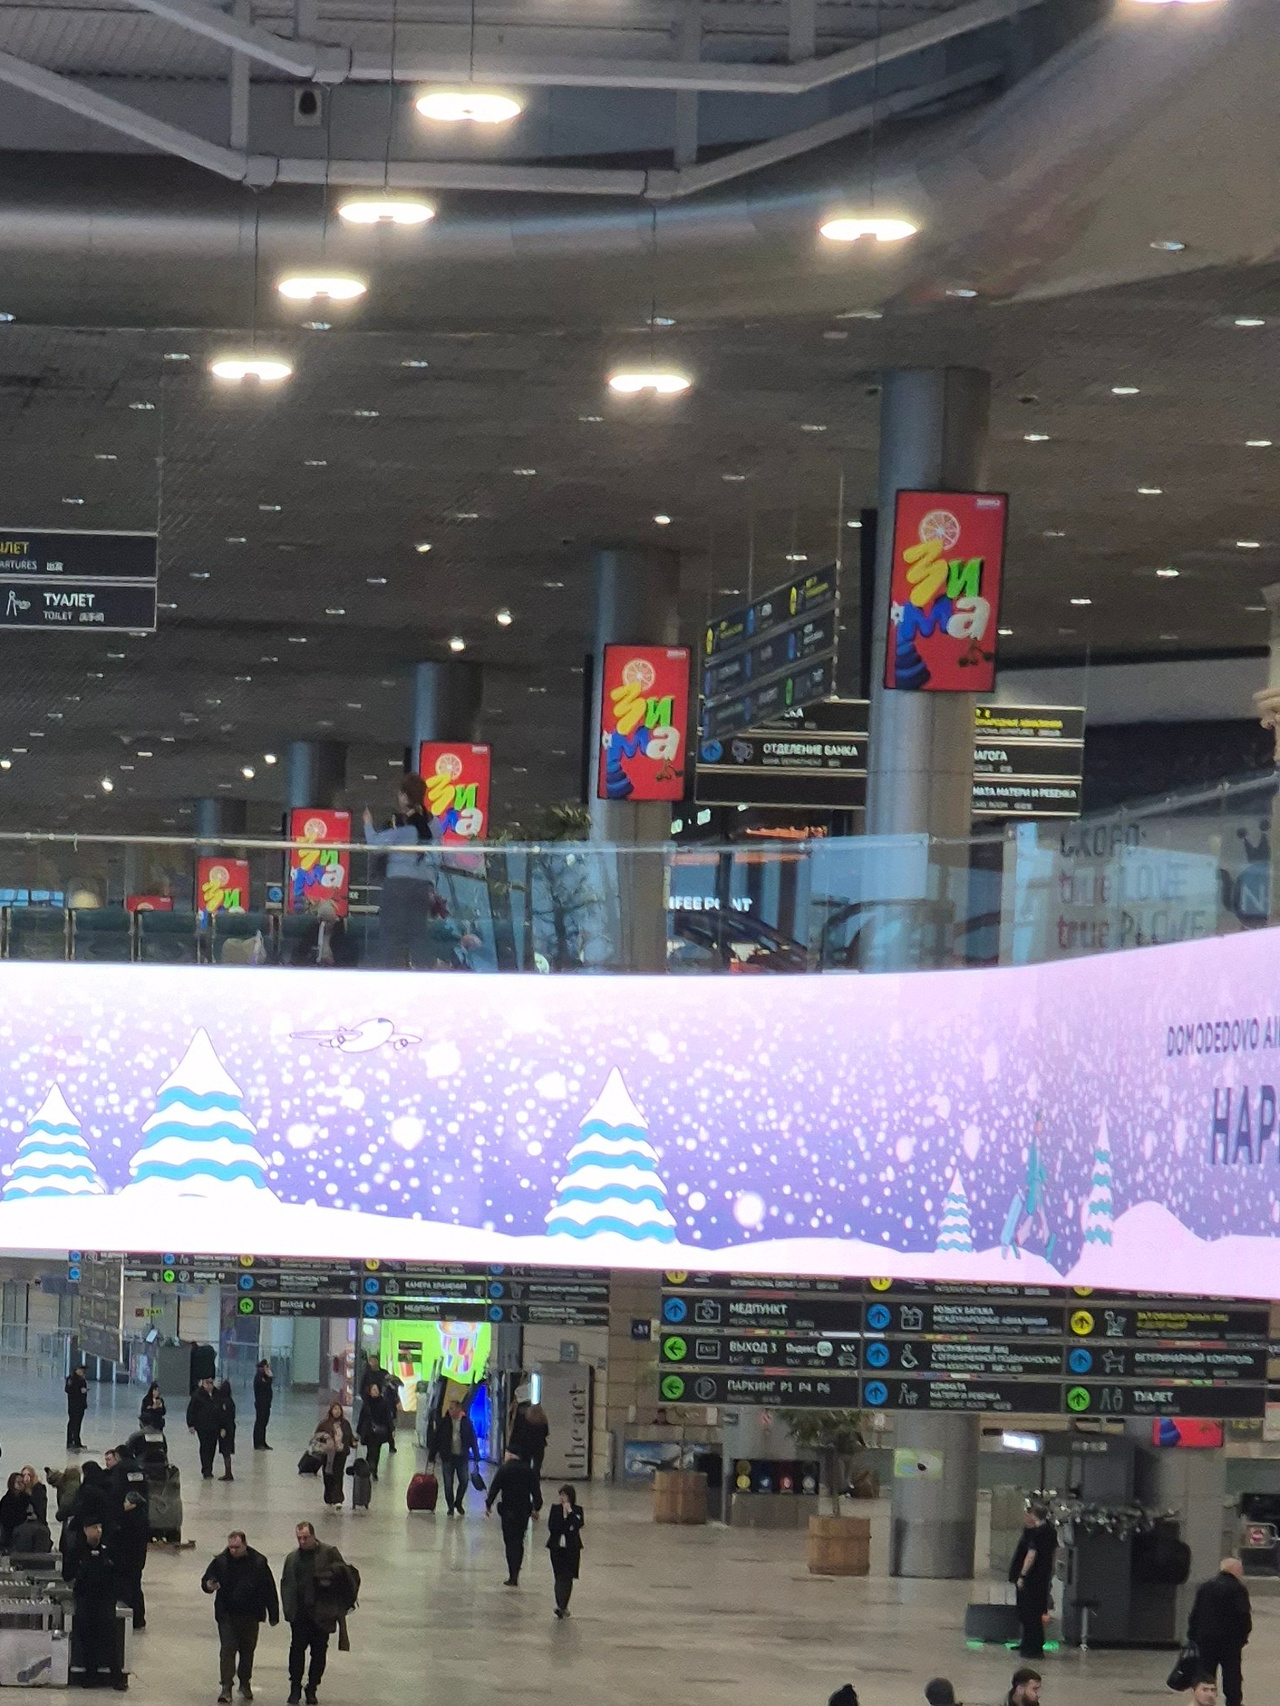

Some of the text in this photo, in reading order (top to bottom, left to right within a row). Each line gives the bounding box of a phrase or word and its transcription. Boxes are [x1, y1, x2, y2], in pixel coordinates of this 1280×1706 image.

[43, 592, 95, 608] ТУАЛЕТ
[43, 610, 73, 622] TOILET
[1167, 1014, 1280, 1057] DOMODEDOVO AI
[1211, 1084, 1280, 1166] HAP
[729, 1302, 788, 1316] МЕДПУНКТ
[730, 1341, 769, 1354] ВЫХОД
[727, 1379, 775, 1392] ПАРКИНГ
